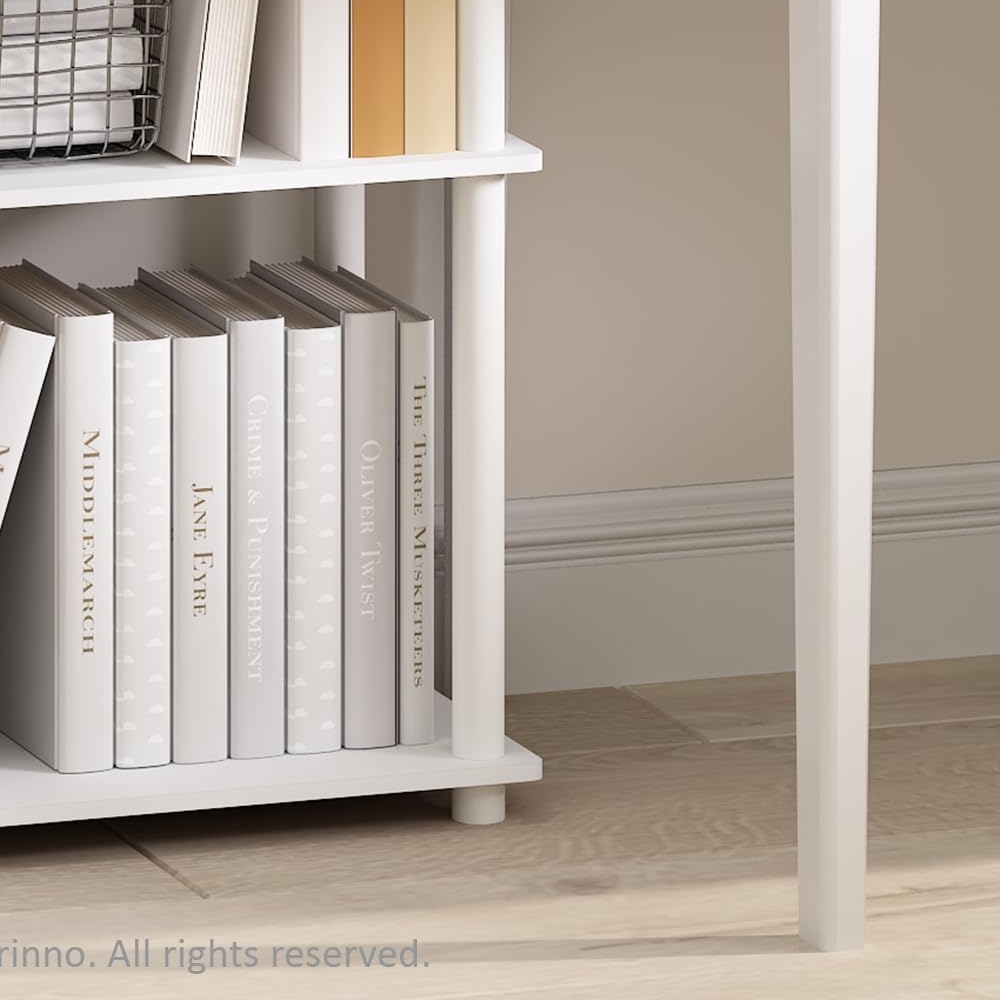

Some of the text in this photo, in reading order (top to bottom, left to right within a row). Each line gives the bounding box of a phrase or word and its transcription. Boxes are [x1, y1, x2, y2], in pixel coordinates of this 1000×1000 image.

[82, 429, 102, 655] MIDDLEMARCH
[192, 482, 214, 618] JANE EYRE
[246, 394, 269, 682] CRIME & PUNISHMENT
[360, 439, 382, 621] OLIVER TWIST
[413, 376, 427, 689] THE THREE MUSKETEERS
